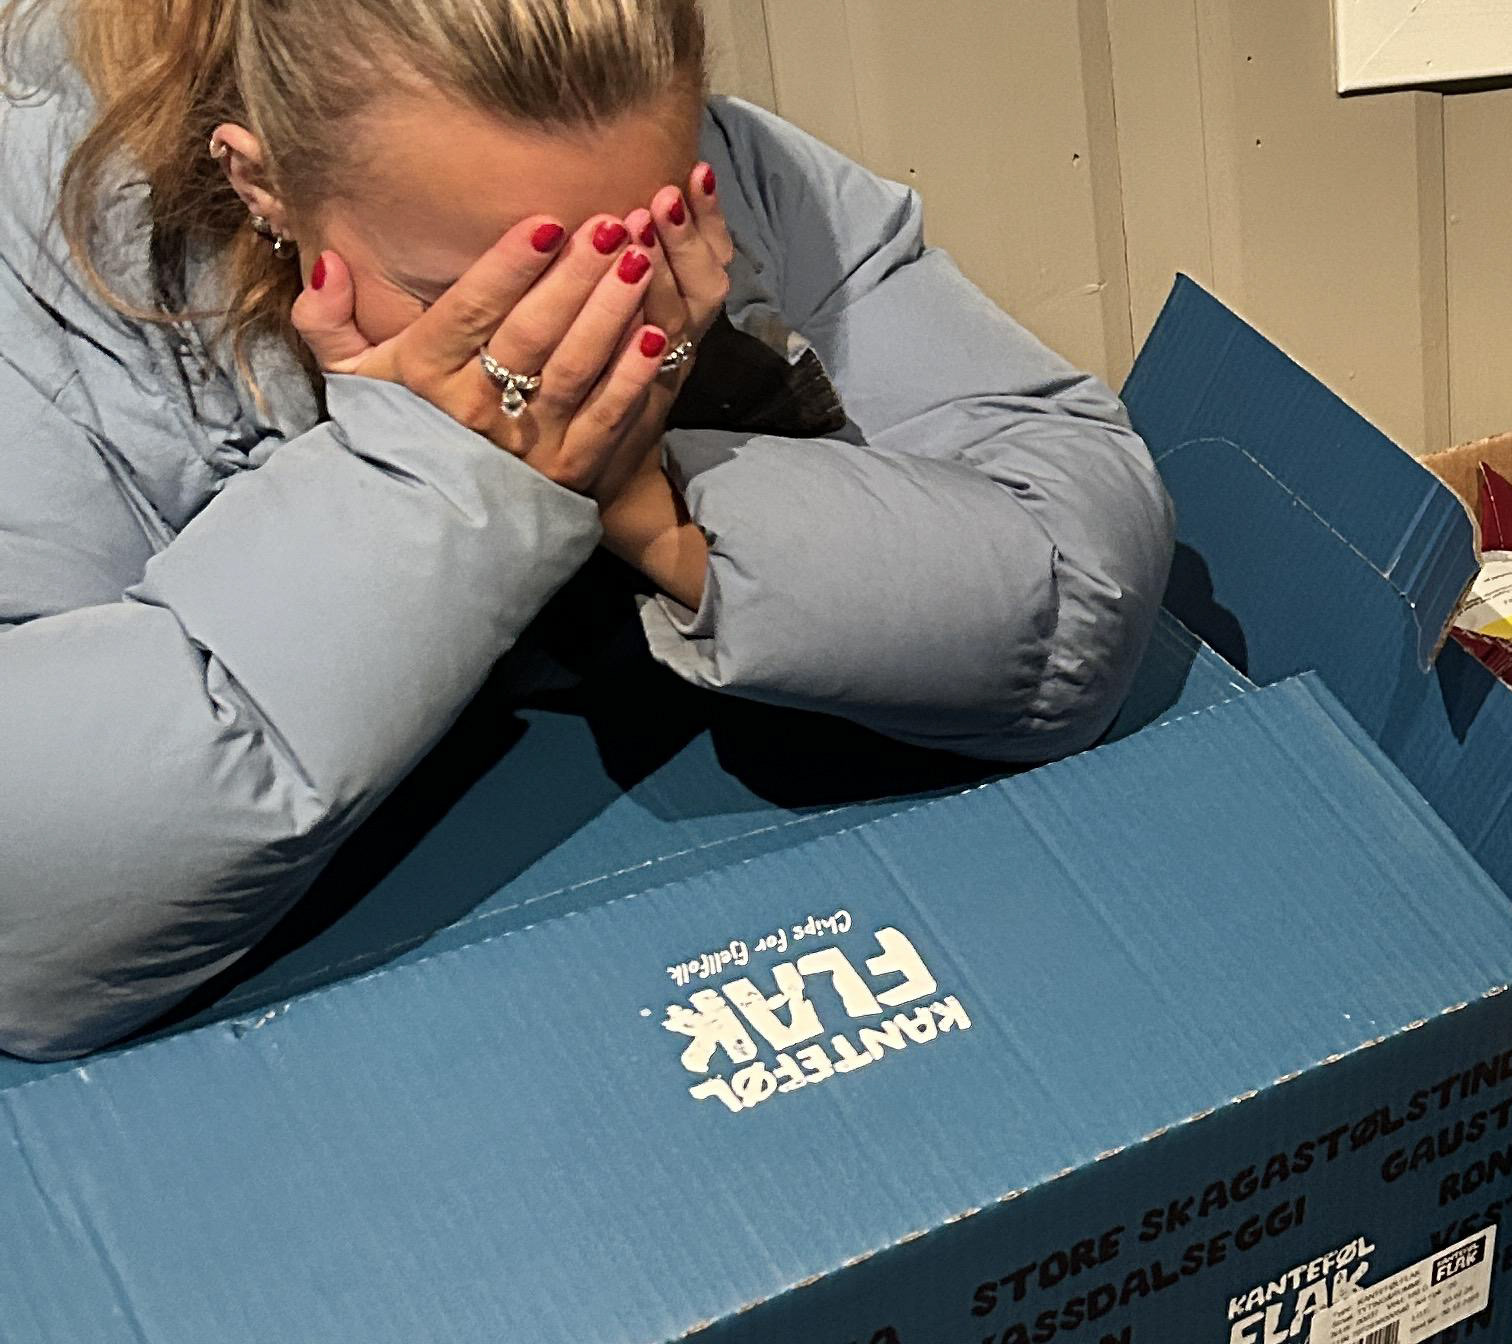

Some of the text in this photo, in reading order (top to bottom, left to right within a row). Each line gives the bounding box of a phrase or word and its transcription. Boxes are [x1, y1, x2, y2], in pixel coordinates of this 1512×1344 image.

[754, 928, 788, 952] for
[793, 909, 852, 940] Chips
[661, 926, 938, 1073] FLAK
[689, 994, 973, 1113] KANTEFØL
[971, 1225, 1125, 1317] STORE
[1228, 1236, 1375, 1320] KANTEFØL
[1436, 1250, 1478, 1281] FLAK
